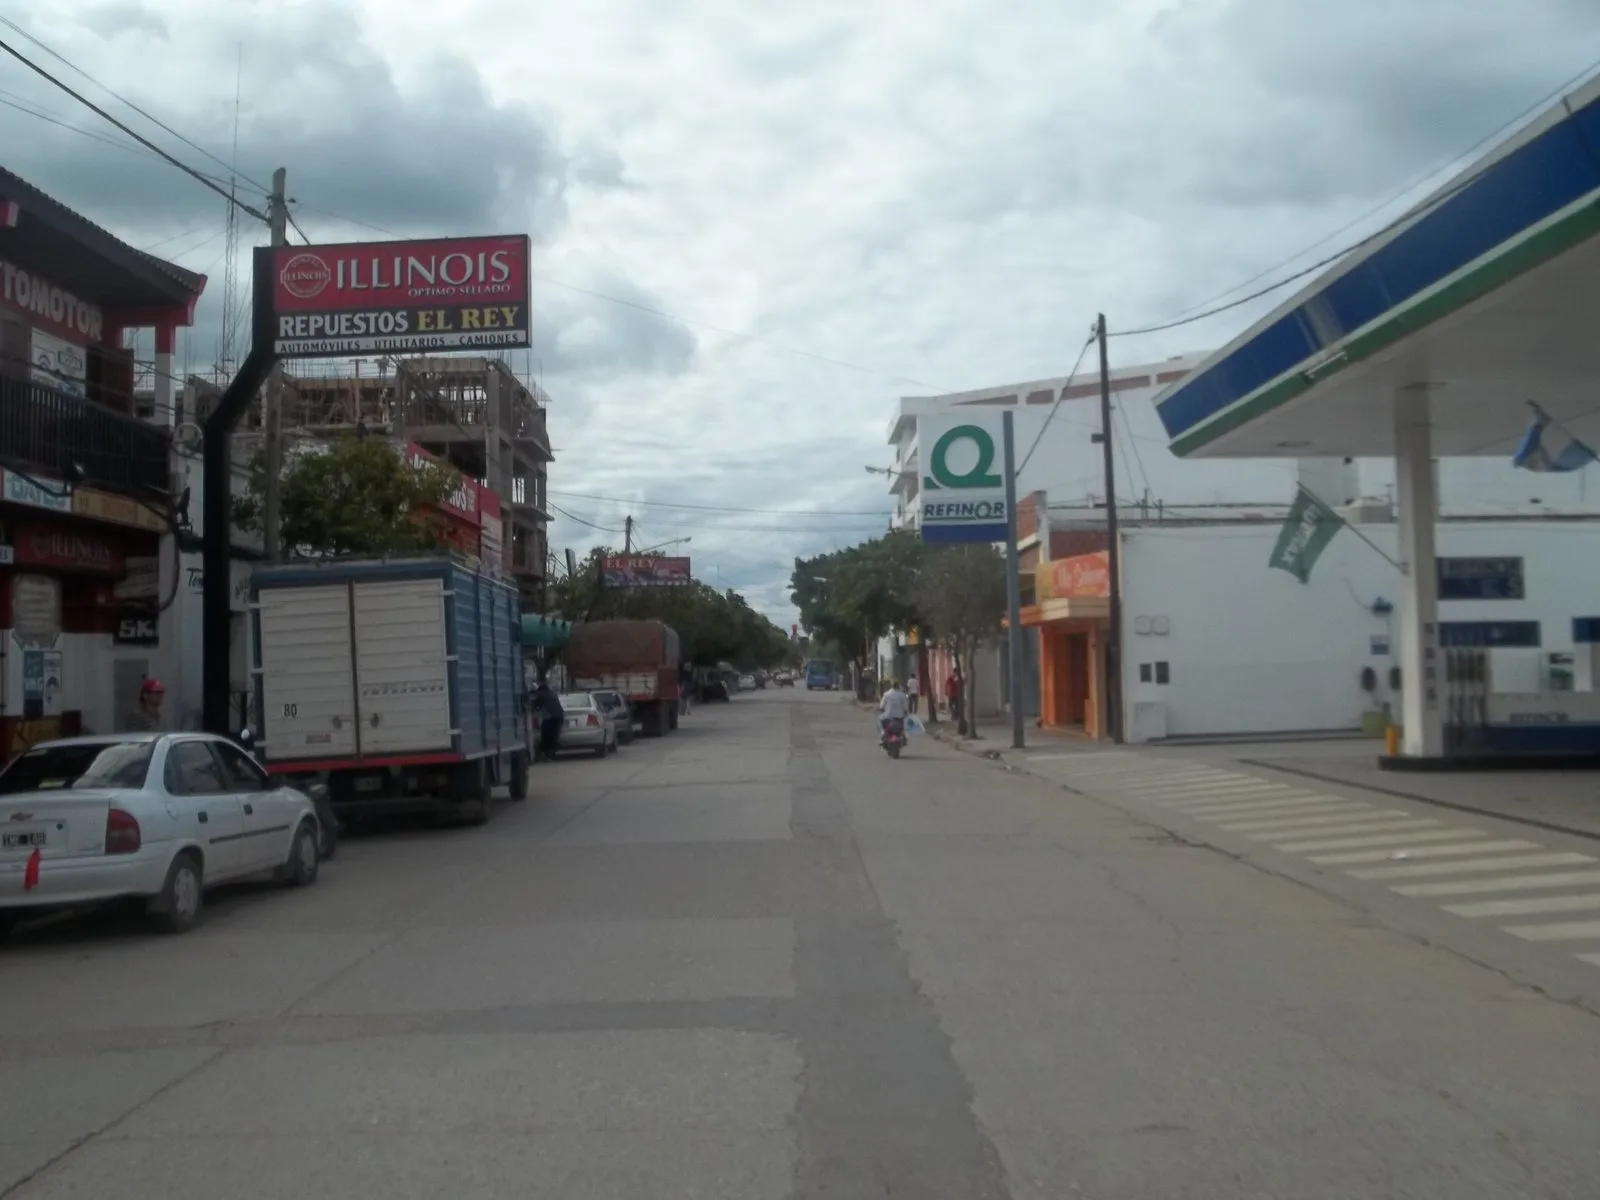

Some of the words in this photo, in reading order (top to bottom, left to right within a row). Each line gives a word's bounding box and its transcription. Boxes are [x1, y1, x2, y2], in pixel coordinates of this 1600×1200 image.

[337, 251, 510, 290] ILLINOIS
[408, 287, 456, 298] OPTIMO
[460, 284, 511, 296] SELLADO
[0, 260, 103, 342] TOMOTOR
[279, 311, 409, 337] REPUESTOS
[416, 310, 453, 331] EL
[460, 306, 519, 330] REY
[374, 336, 446, 350] UTILITARIOS
[459, 333, 519, 345] CAMIONES
[924, 501, 1005, 519] REFINOR
[606, 558, 624, 569] EL
[628, 557, 656, 569] REY
[119, 619, 159, 638] SK
[283, 703, 298, 718] 80
